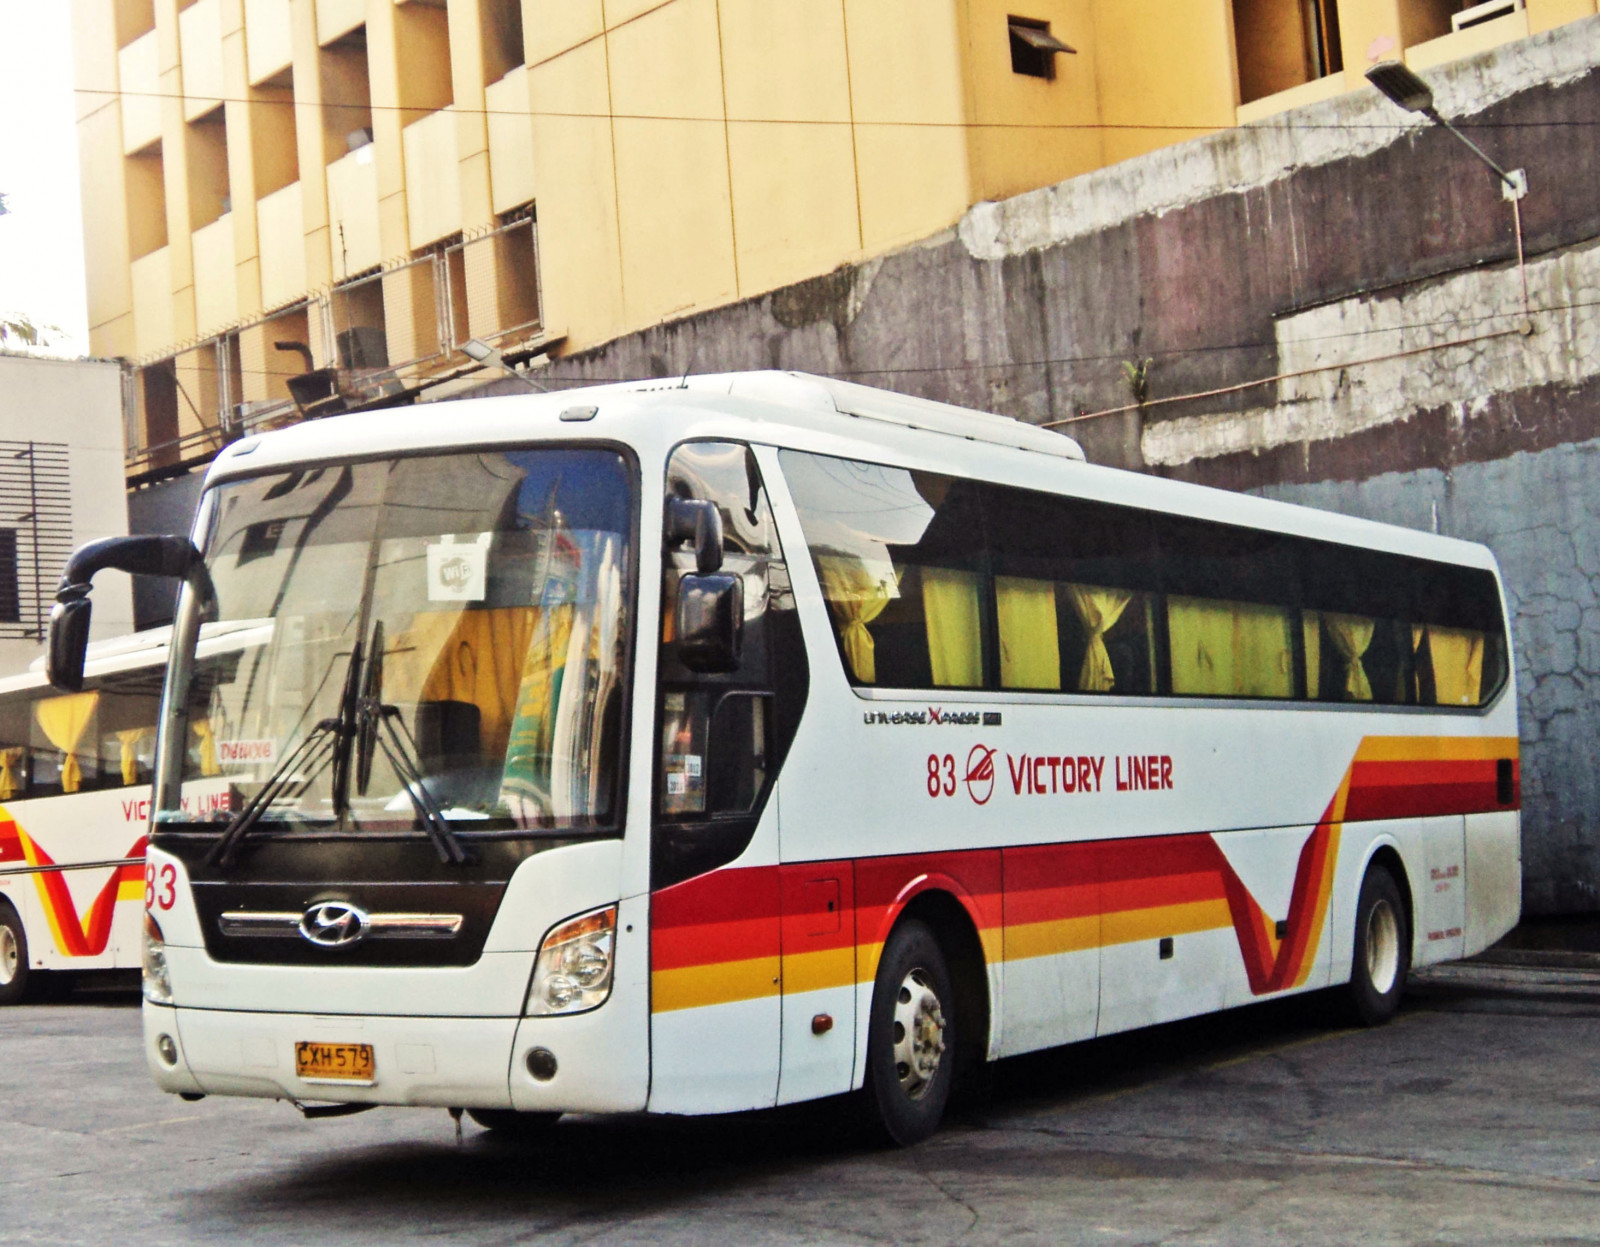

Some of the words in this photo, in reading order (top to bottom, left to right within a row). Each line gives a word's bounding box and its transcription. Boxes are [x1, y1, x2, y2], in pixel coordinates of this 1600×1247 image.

[927, 753, 956, 798] 83
[1006, 752, 1106, 795] VICTORY
[1115, 755, 1174, 791] LINER
[145, 863, 177, 911] 83
[298, 1047, 332, 1067] CXH
[336, 1048, 369, 1068] 579
